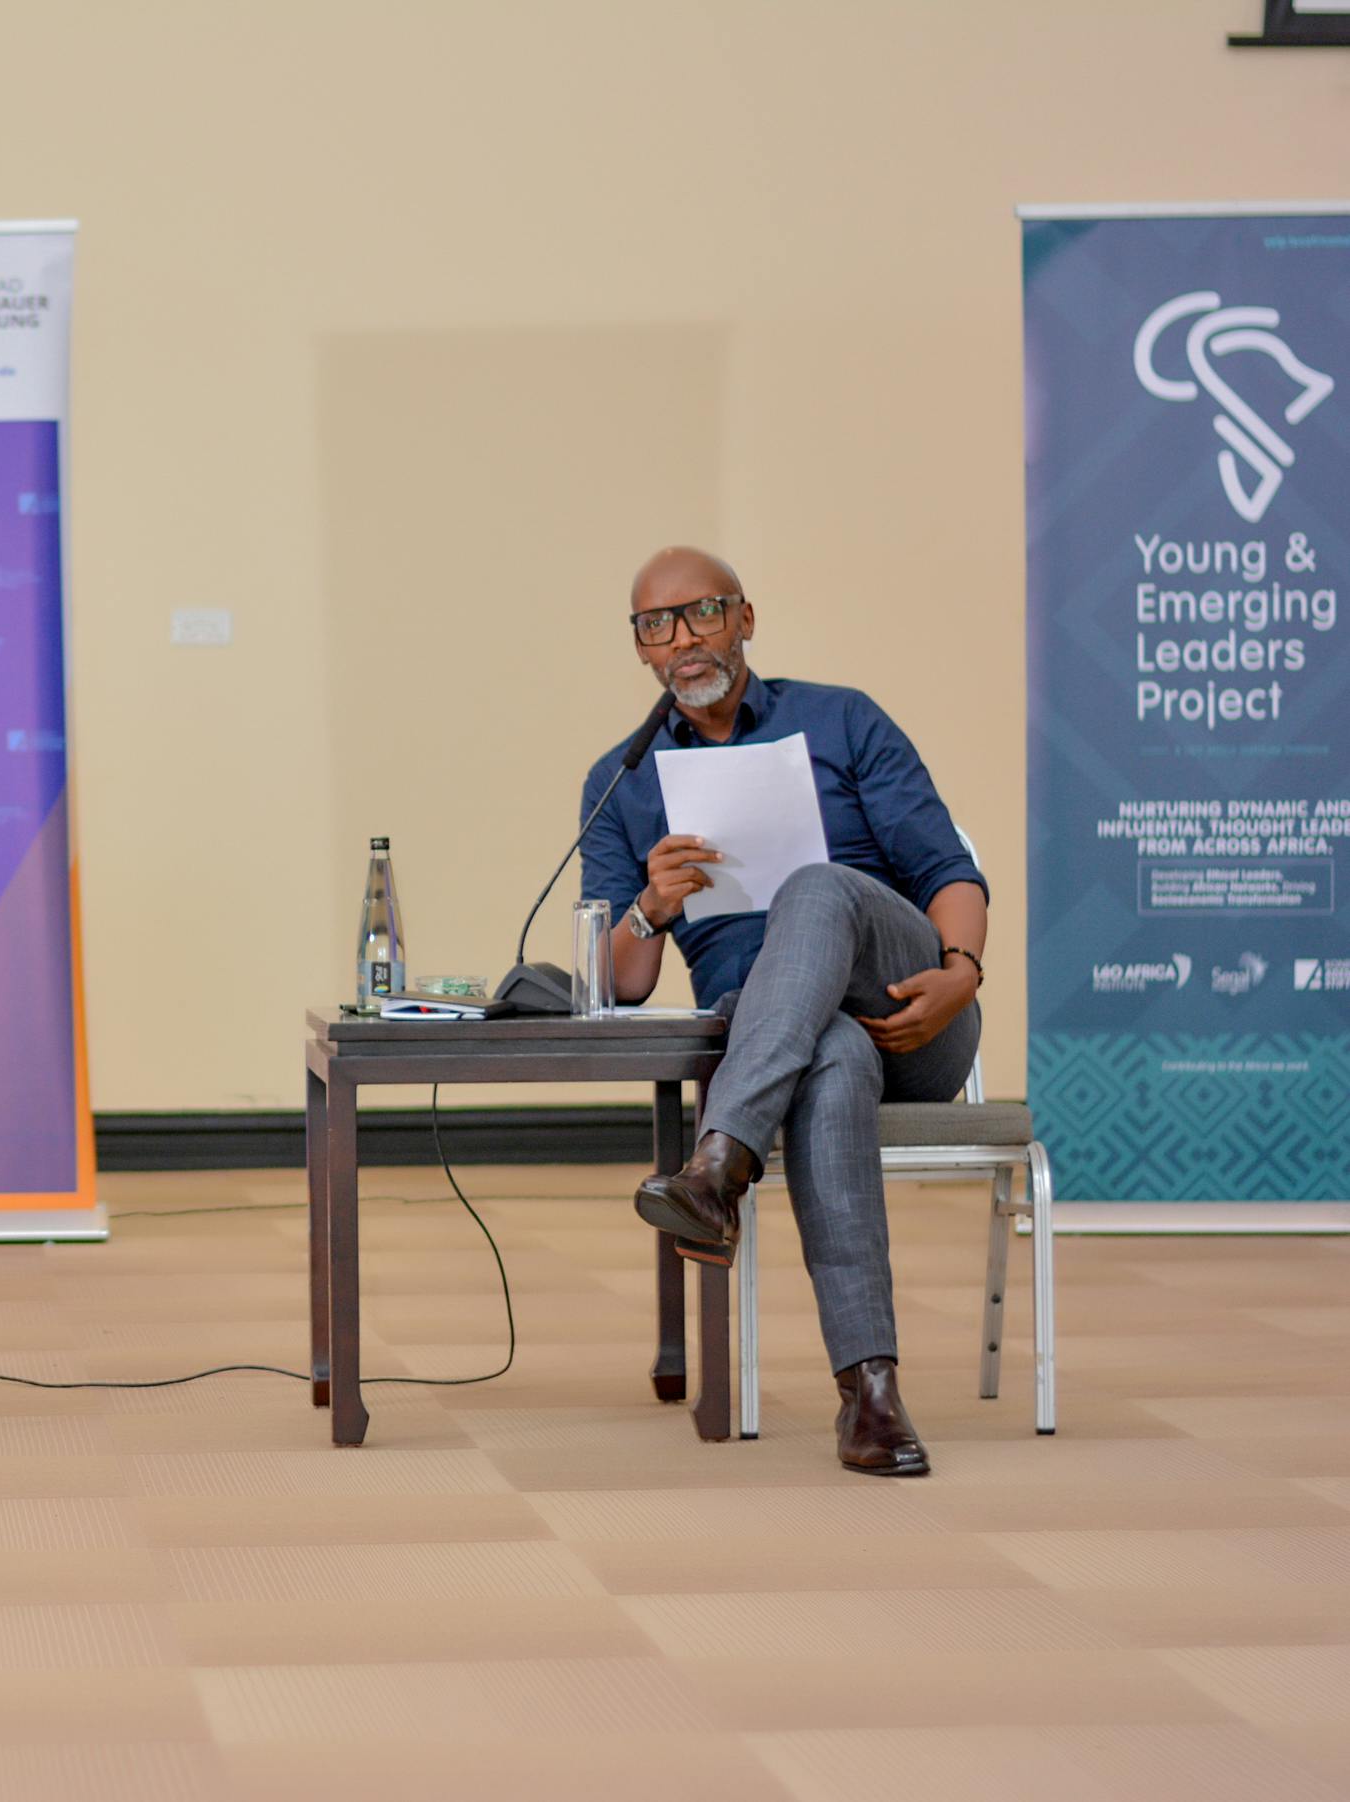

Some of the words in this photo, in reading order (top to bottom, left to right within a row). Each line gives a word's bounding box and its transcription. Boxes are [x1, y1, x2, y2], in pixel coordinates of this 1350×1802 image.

[1134, 533, 1267, 583] Young
[1285, 532, 1317, 573] &
[1137, 581, 1338, 632] Emerging
[1137, 628, 1306, 673] Leaders
[1137, 680, 1283, 731] Project
[1119, 800, 1223, 819] NURTURING
[1228, 800, 1309, 818] DYNAMIC
[1314, 799, 1350, 817] AND
[1097, 819, 1204, 839] INFLUENTIAL
[1209, 818, 1295, 837] THOUGHT
[1138, 838, 1187, 857] FROM
[1192, 837, 1261, 856] ACROSS
[1125, 961, 1177, 982] AFRICA
